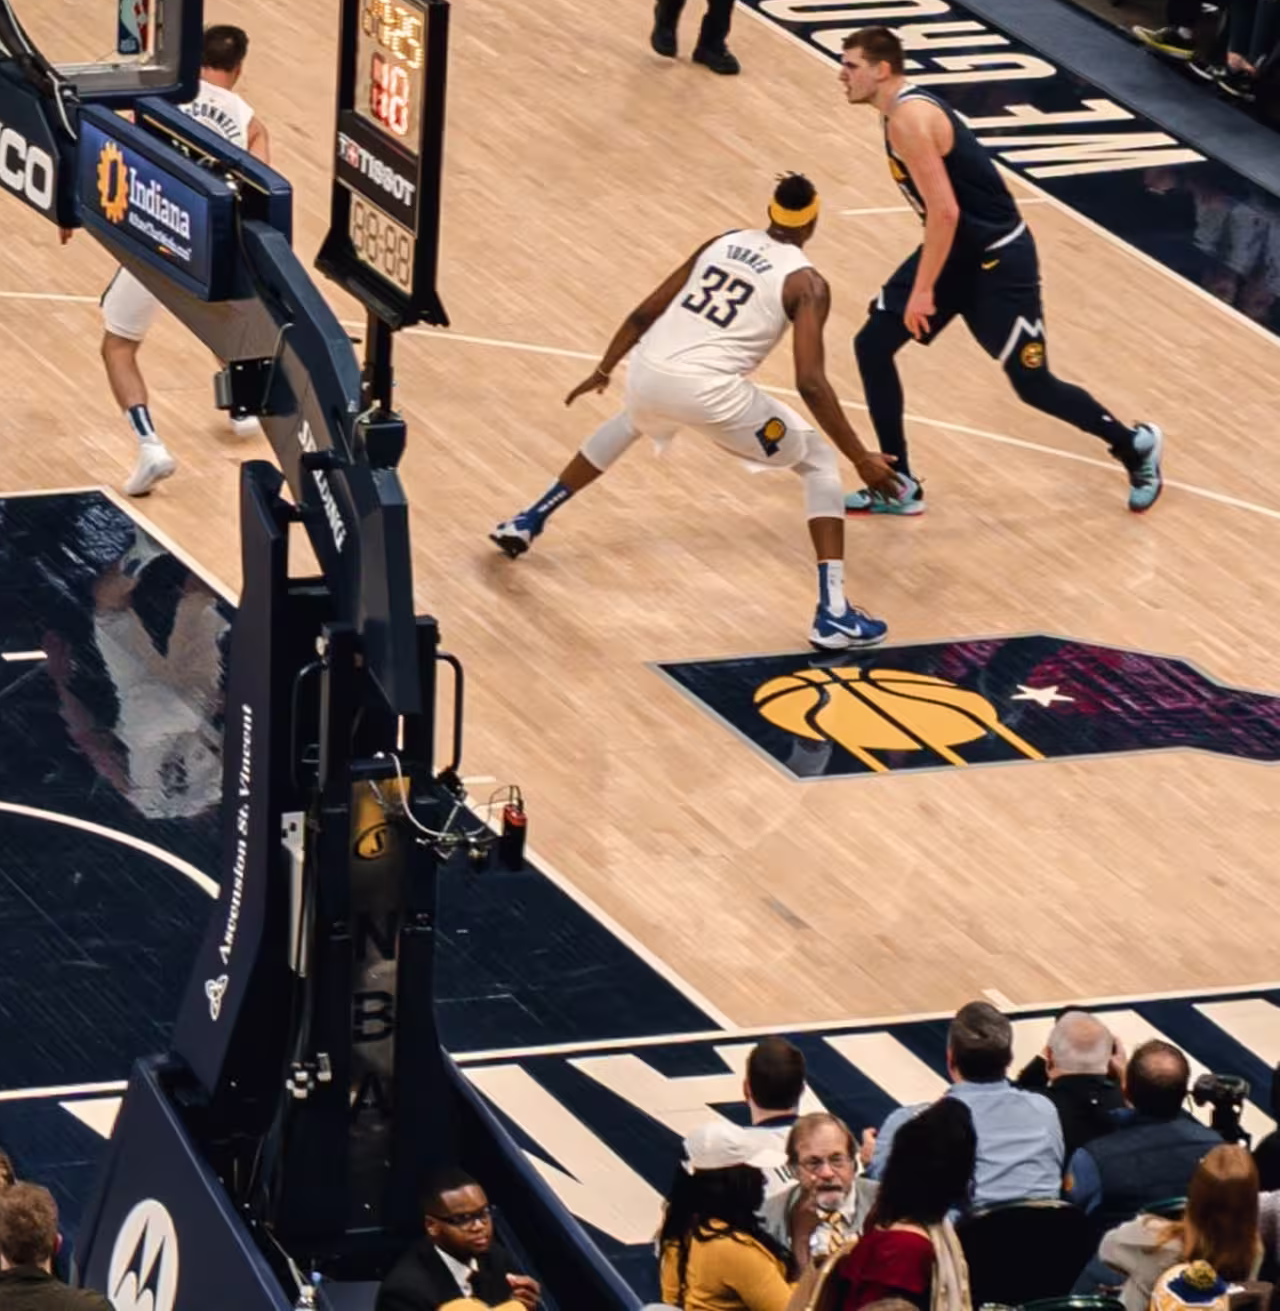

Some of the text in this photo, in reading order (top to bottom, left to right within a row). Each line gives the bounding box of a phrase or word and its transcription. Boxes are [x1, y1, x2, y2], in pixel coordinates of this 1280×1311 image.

[129, 166, 190, 240] Indiana
[681, 265, 756, 328] 33
[218, 838, 248, 966] Ascension
[238, 702, 254, 798] Vincent
